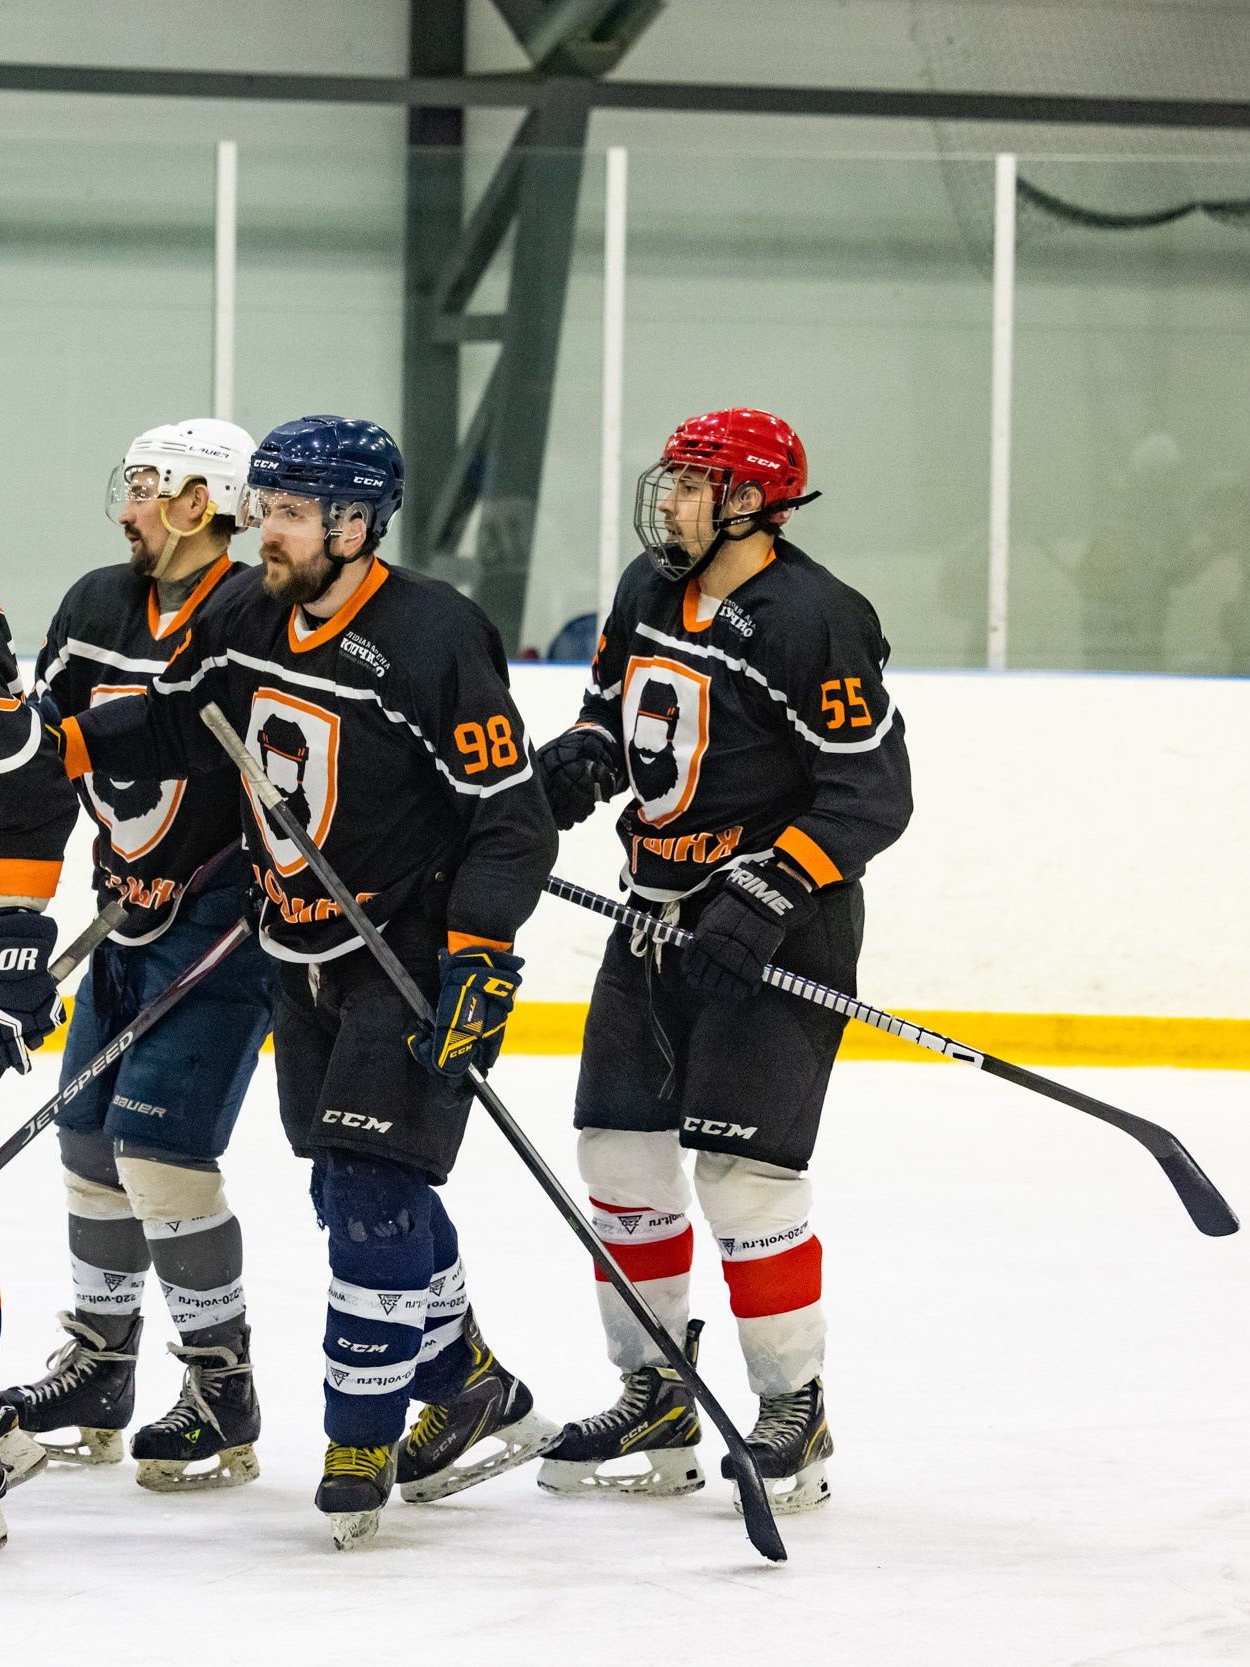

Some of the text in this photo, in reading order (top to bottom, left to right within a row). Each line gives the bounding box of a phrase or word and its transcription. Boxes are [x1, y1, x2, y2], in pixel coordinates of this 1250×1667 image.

[253, 459, 280, 470] CCM
[747, 454, 781, 470] CCM
[353, 476, 384, 488] CCM
[820, 677, 873, 729] 55
[453, 714, 518, 775] 98
[22, 1031, 134, 1146] JETSPEED
[322, 1109, 394, 1134] CCM
[683, 1116, 759, 1140] CCM
[380, 1297, 398, 1307] 220
[337, 1336, 390, 1354] CCM
[620, 1420, 649, 1446] CCM
